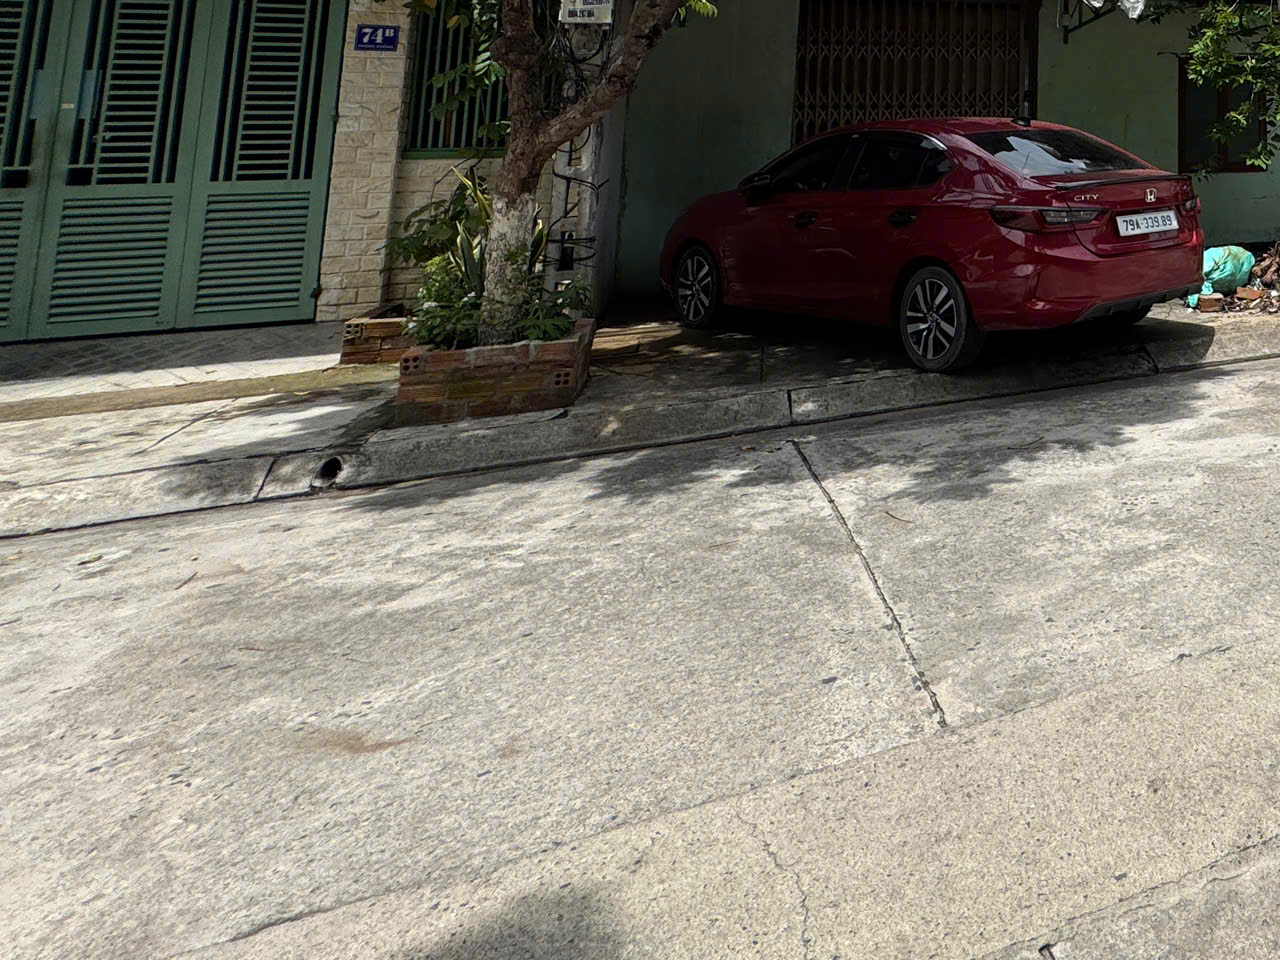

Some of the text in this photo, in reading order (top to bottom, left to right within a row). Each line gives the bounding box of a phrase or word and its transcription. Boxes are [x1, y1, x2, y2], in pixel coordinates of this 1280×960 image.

[361, 28, 395, 43] 74B
[1073, 194, 1099, 202] CITY
[1122, 215, 1173, 232] 79A-339.89
